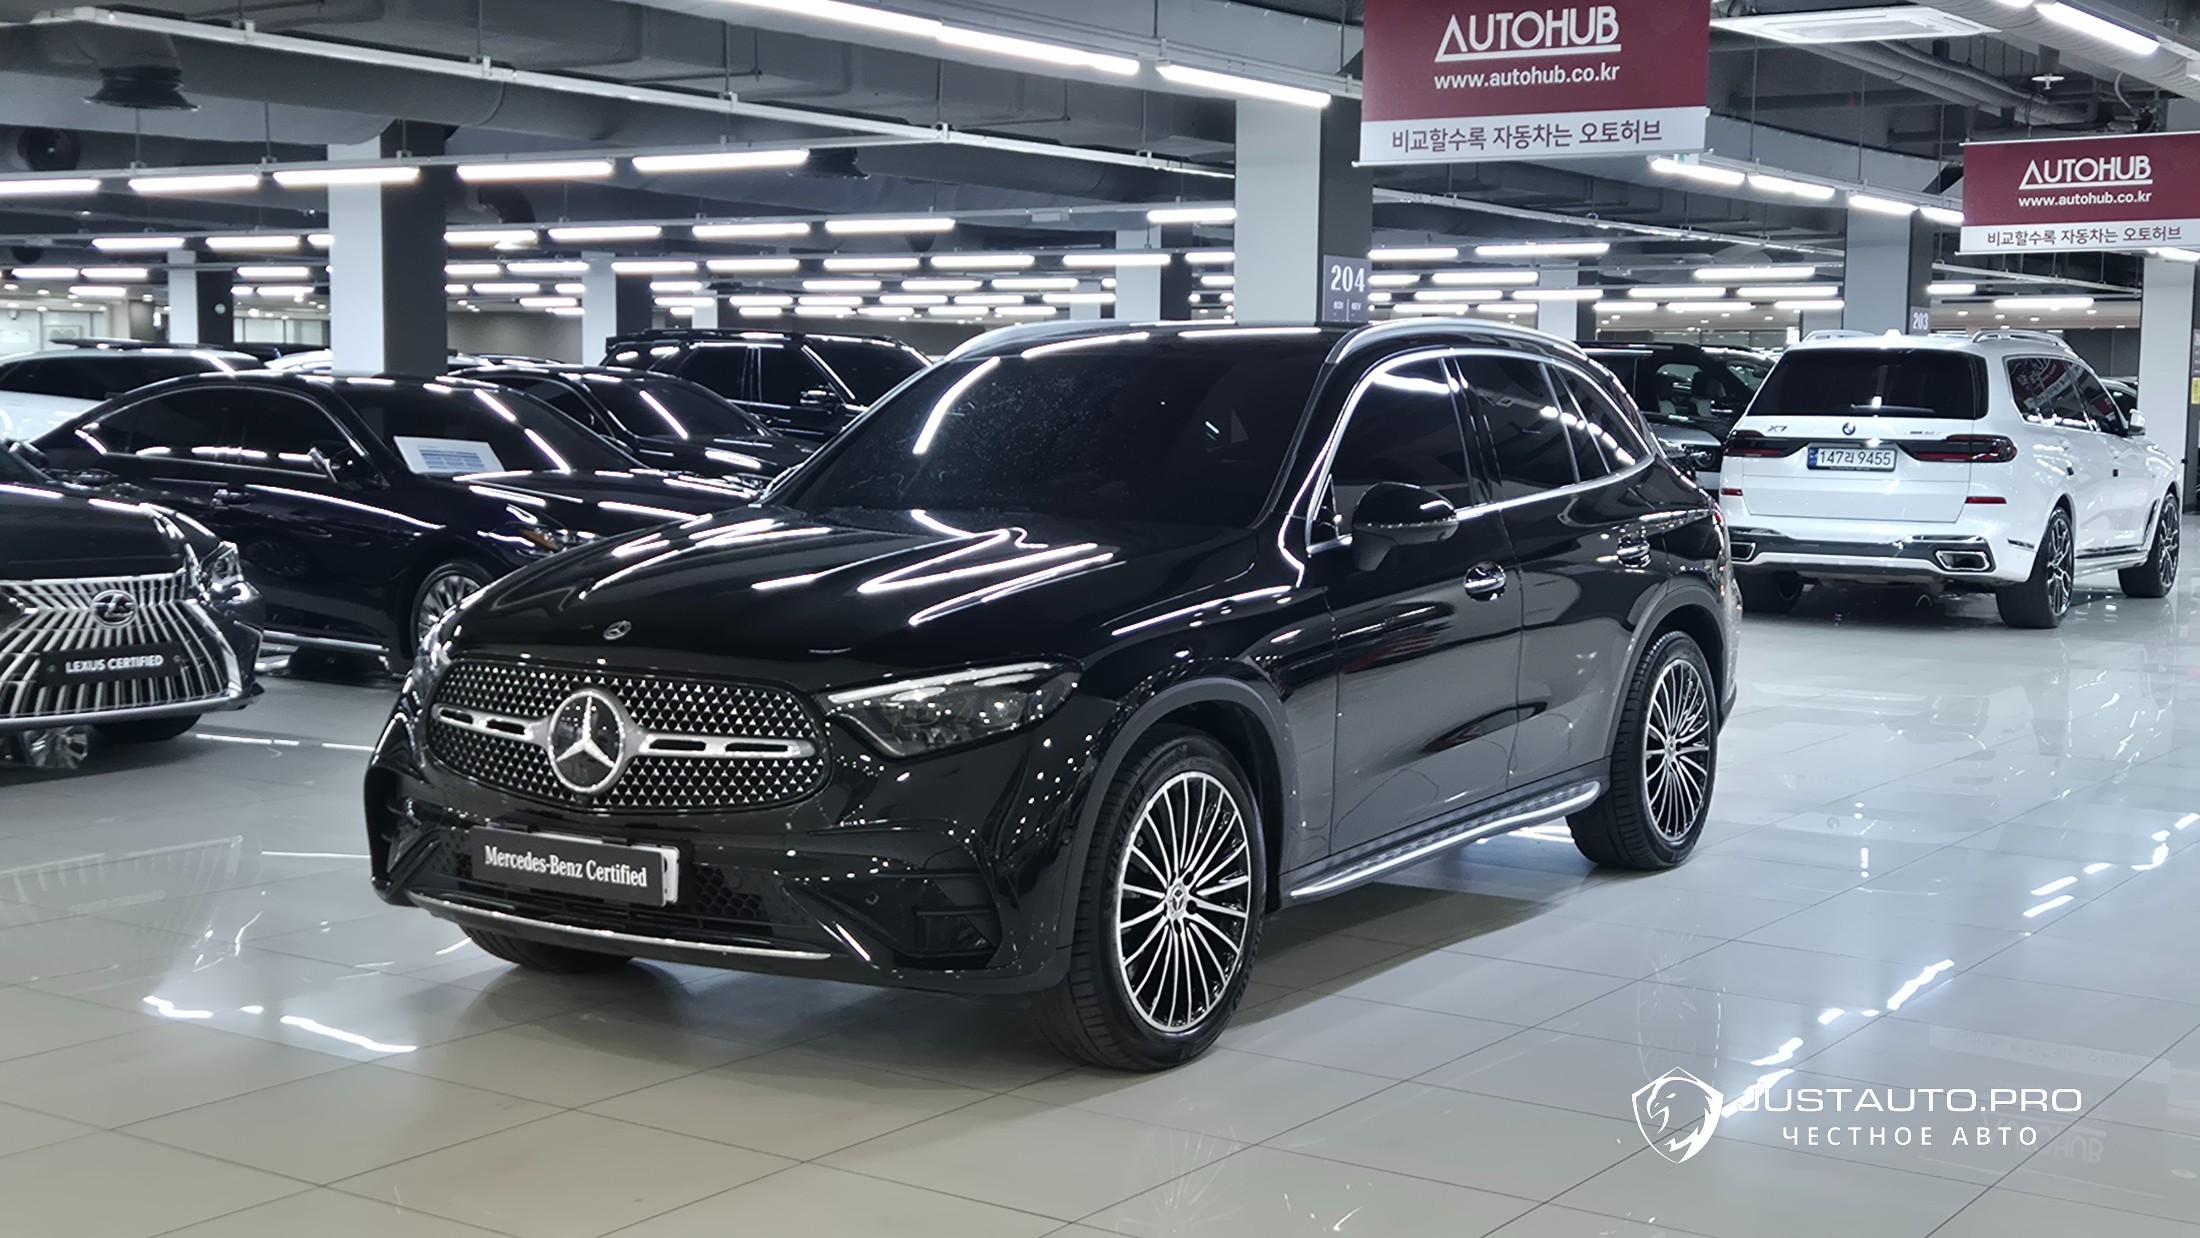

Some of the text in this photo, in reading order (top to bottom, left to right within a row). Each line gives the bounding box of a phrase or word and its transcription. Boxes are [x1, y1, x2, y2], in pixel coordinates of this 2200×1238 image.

[1434, 5, 1621, 62] AUTOHUB
[1434, 63, 1620, 90] www.autohub.co.kr
[1391, 119, 1663, 153] 비교할수록 자동차는 오토허브
[2018, 155, 2153, 190] AUTOHUB
[2018, 190, 2153, 207] www.autohub.co.kr
[1987, 225, 2182, 247] 비교할수록 자동차는 오토허브
[1330, 264, 1365, 292] 204
[1912, 312, 1929, 330] 203
[1767, 424, 1788, 432] X7
[1857, 451, 1891, 466] 9455
[65, 655, 164, 673] LEXUS CERTIFIED
[485, 845, 647, 887] Mercedes-Benz Certified
